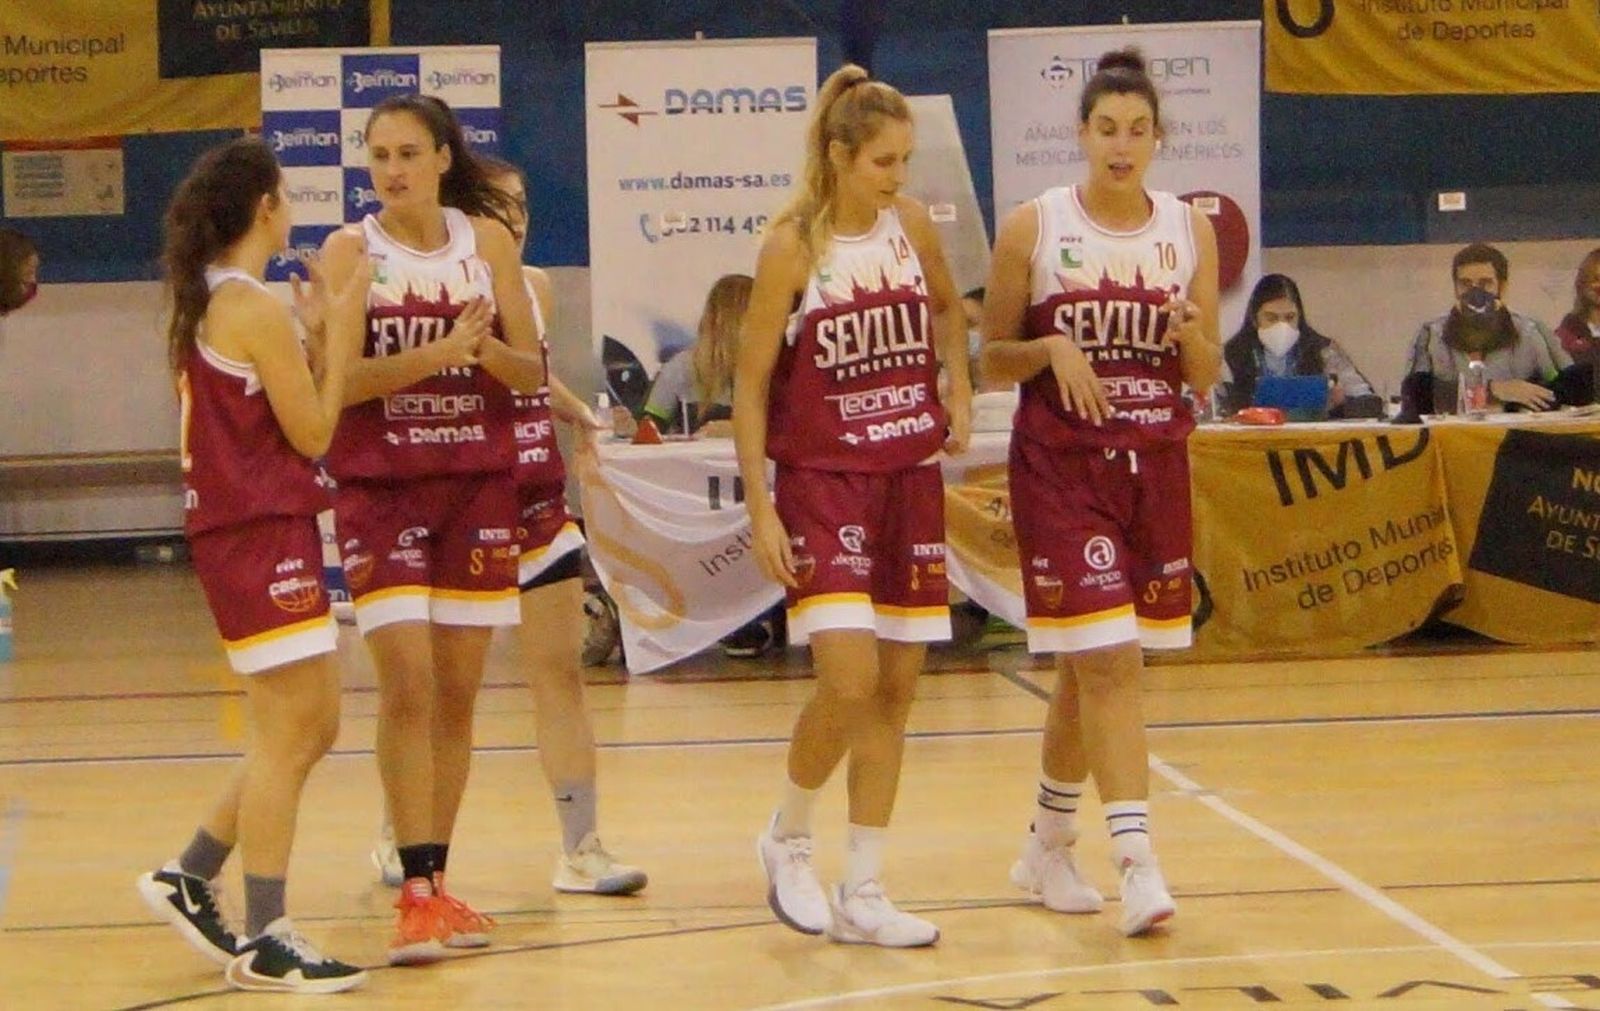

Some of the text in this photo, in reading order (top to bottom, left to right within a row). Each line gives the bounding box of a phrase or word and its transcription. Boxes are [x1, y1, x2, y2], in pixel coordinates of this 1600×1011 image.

[1400, 20, 1536, 41] de Deportes
[5, 33, 124, 57] Municipal
[665, 86, 807, 114] DAMAS
[618, 172, 792, 191] www.damas-sa.es
[705, 216, 735, 234] 114
[1155, 242, 1177, 271] 10
[408, 425, 486, 444] DAMAS
[1266, 427, 1430, 507] IMD
[1546, 530, 1577, 554] DE
[1242, 540, 1362, 593] Instituto
[1297, 581, 1334, 609] de
